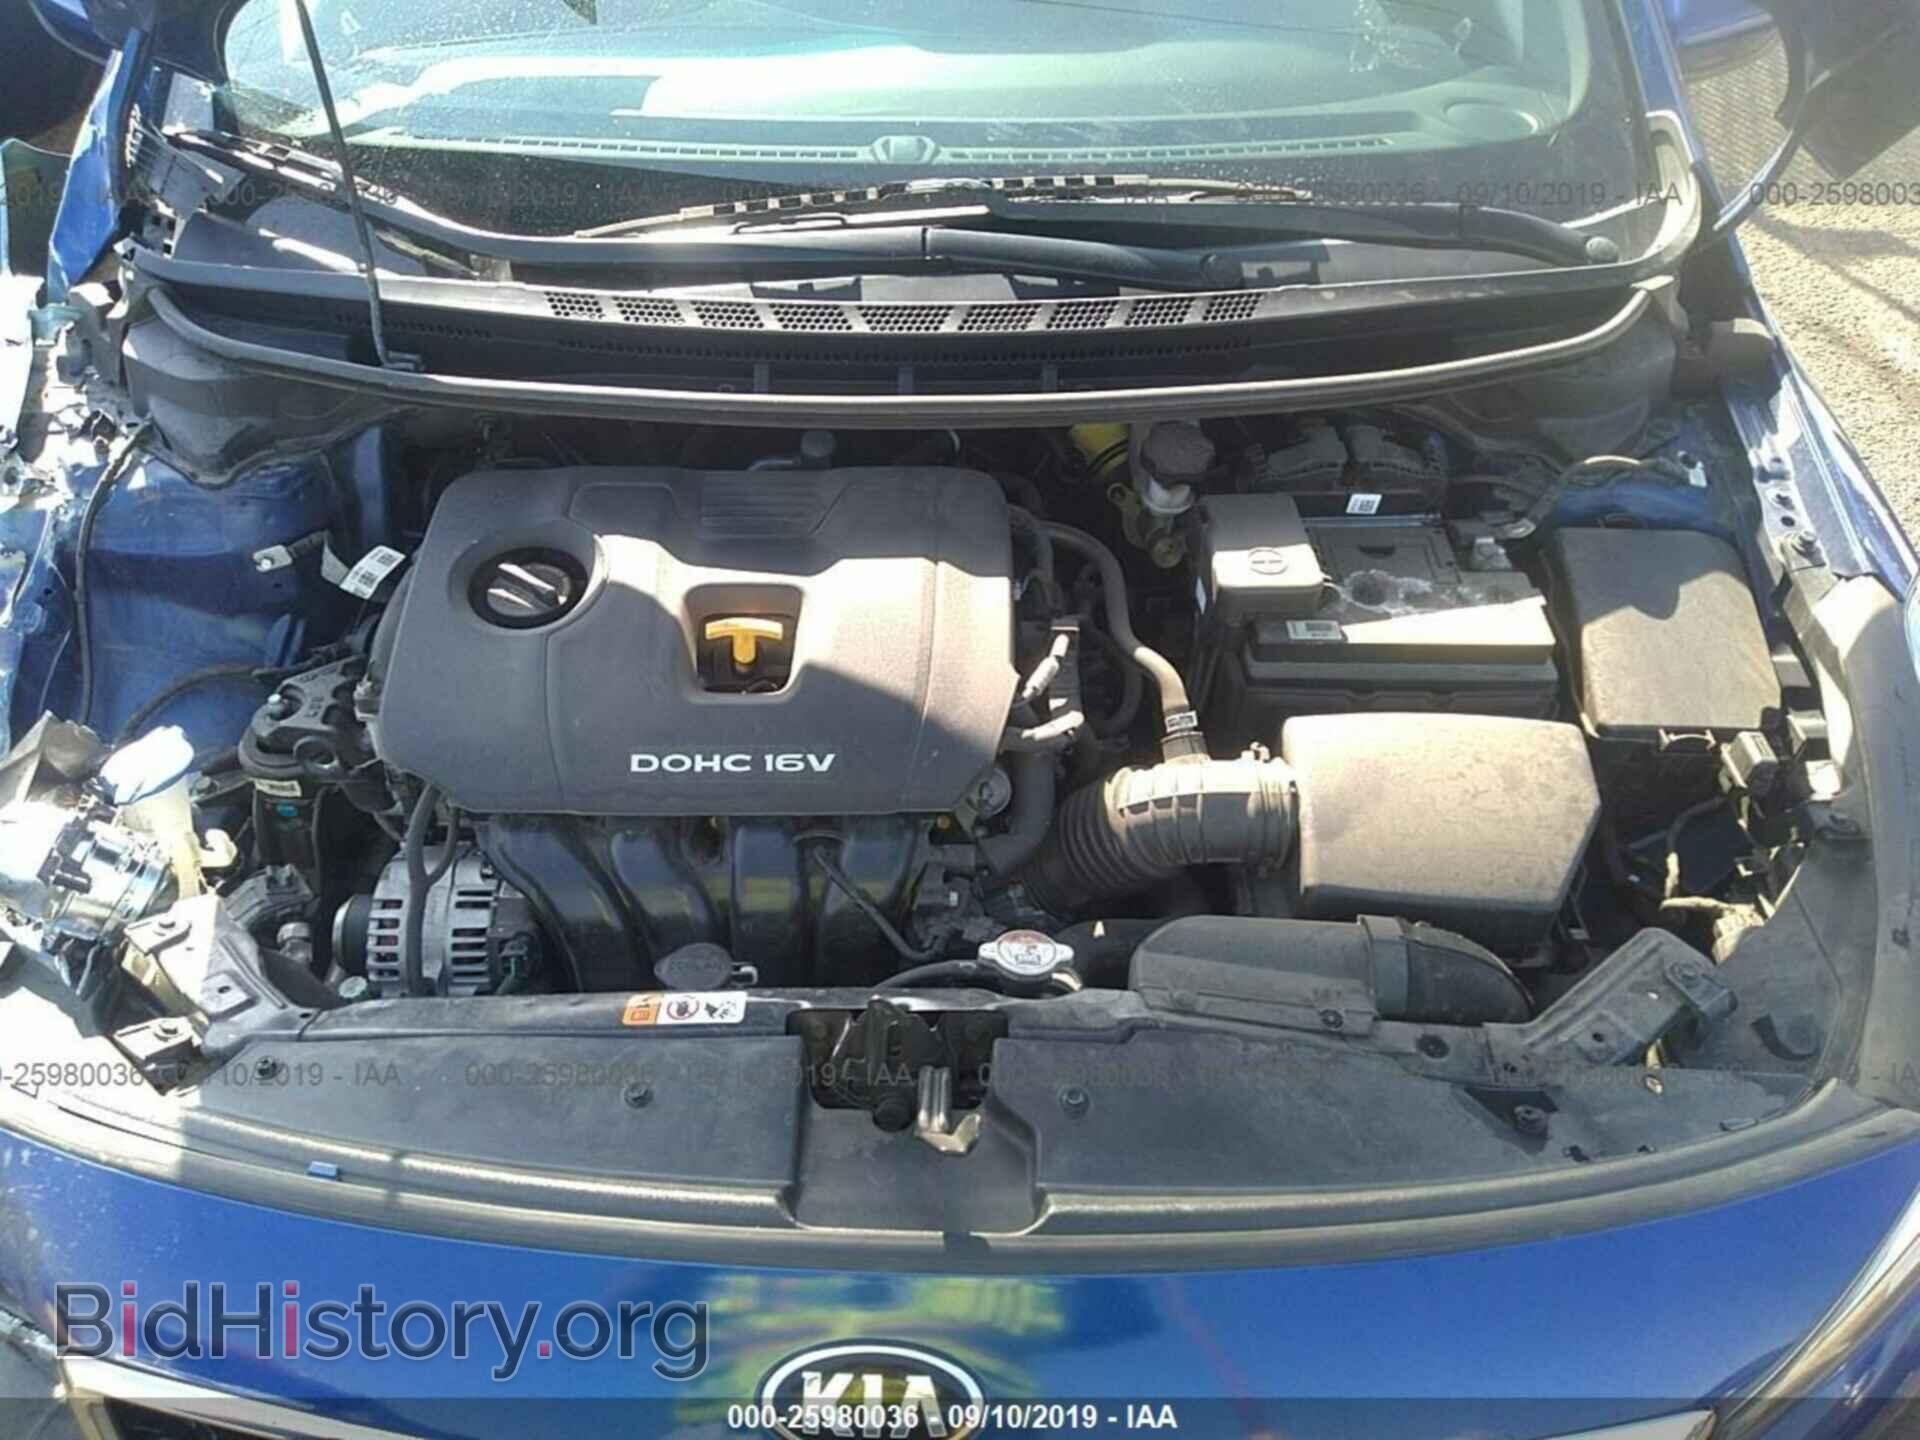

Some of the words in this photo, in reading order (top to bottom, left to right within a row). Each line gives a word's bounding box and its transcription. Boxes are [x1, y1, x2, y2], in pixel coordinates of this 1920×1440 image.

[630, 754, 752, 772] DOHC
[764, 754, 835, 772] 16V
[801, 1371, 948, 1439] KIA
